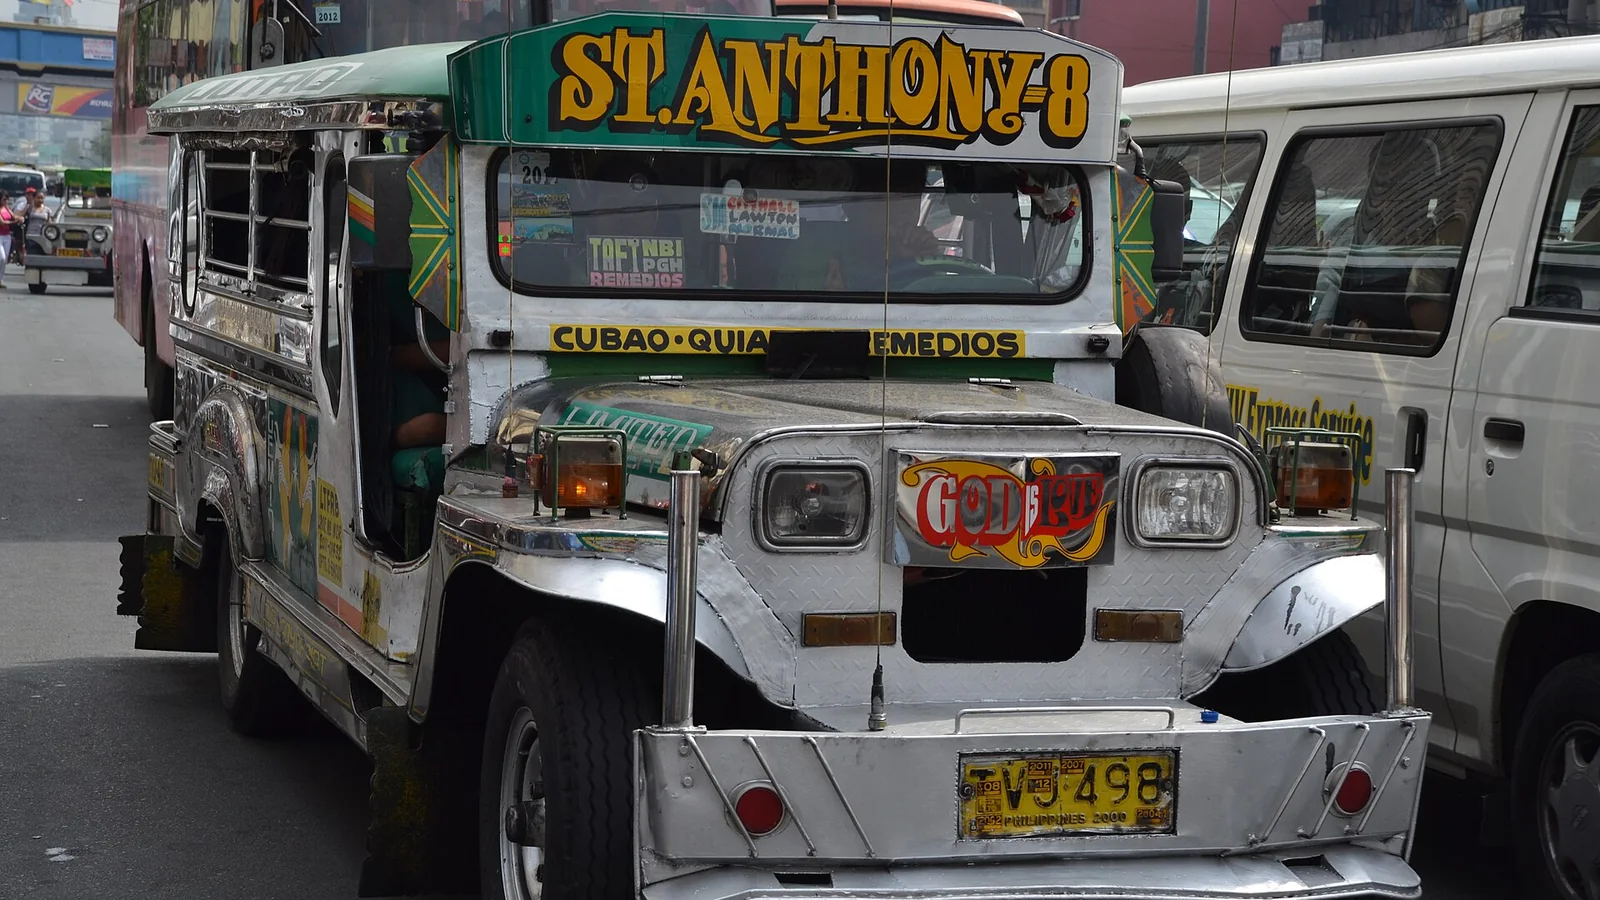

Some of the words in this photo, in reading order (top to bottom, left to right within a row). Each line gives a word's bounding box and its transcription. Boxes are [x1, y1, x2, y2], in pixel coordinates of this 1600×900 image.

[319, 12, 338, 21] 2012
[28, 88, 51, 103] RC
[729, 211, 797, 225] LAWTON
[643, 239, 682, 256] NBI
[642, 258, 683, 273] PGH
[590, 272, 683, 288] REMEDIOS
[688, 328, 768, 354] QUIA
[868, 332, 1019, 357] EMEDIOS
[922, 474, 1022, 540] GOD
[1025, 484, 1039, 534] IS
[1038, 476, 1104, 527] LOVE
[1029, 762, 1052, 771] 2011
[1061, 761, 1084, 769] 2007
[1074, 761, 1164, 805] 498
[1004, 814, 1087, 827] PHILIPPINES
[1092, 811, 1128, 824] 2000
